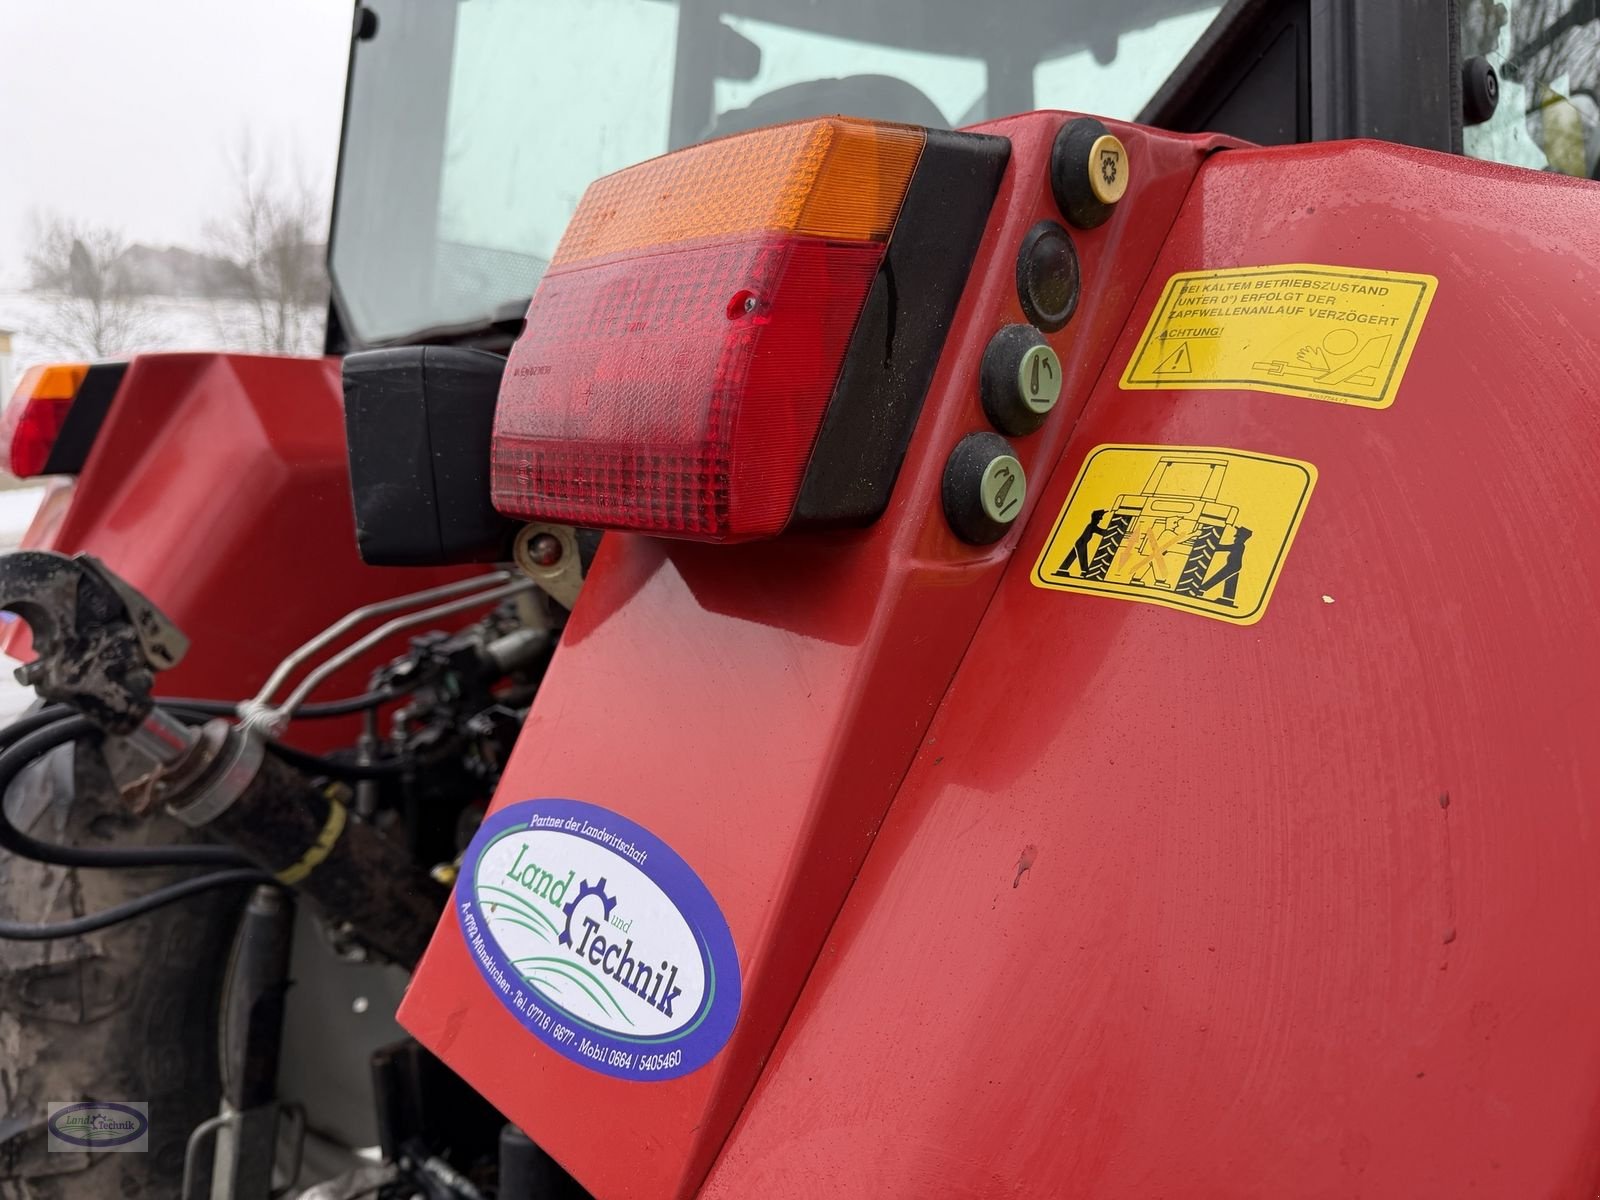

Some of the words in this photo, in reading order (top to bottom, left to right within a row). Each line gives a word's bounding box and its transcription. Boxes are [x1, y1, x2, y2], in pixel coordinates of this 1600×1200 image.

[1180, 284, 1201, 295] BEI
[1203, 281, 1251, 293] KALTEM
[1254, 279, 1389, 296] BETRIEBSZUSTAND
[1240, 292, 1305, 303] ERFOLGT
[1306, 294, 1336, 305] DER
[1168, 306, 1305, 319] ZAPFWELLENANLAUF
[1309, 308, 1399, 326] VERZÖGERT
[1159, 327, 1225, 338] ACHTUNG!
[530, 814, 565, 828] Partner
[565, 815, 581, 832] der
[581, 820, 648, 866] Landwirtschaft
[506, 843, 576, 908] Land
[612, 914, 633, 934] und
[575, 916, 682, 1019] Technik
[461, 902, 479, 939] A-4792
[472, 933, 511, 994] Münzkirchen
[513, 990, 528, 1012] Tel.
[527, 1003, 551, 1031] 07716
[548, 1021, 556, 1033] /
[553, 1024, 575, 1046] 6677
[578, 1037, 609, 1063] Mobil
[608, 1046, 633, 1070] 0664
[632, 1053, 639, 1070] /
[639, 1045, 682, 1071] 5405460
